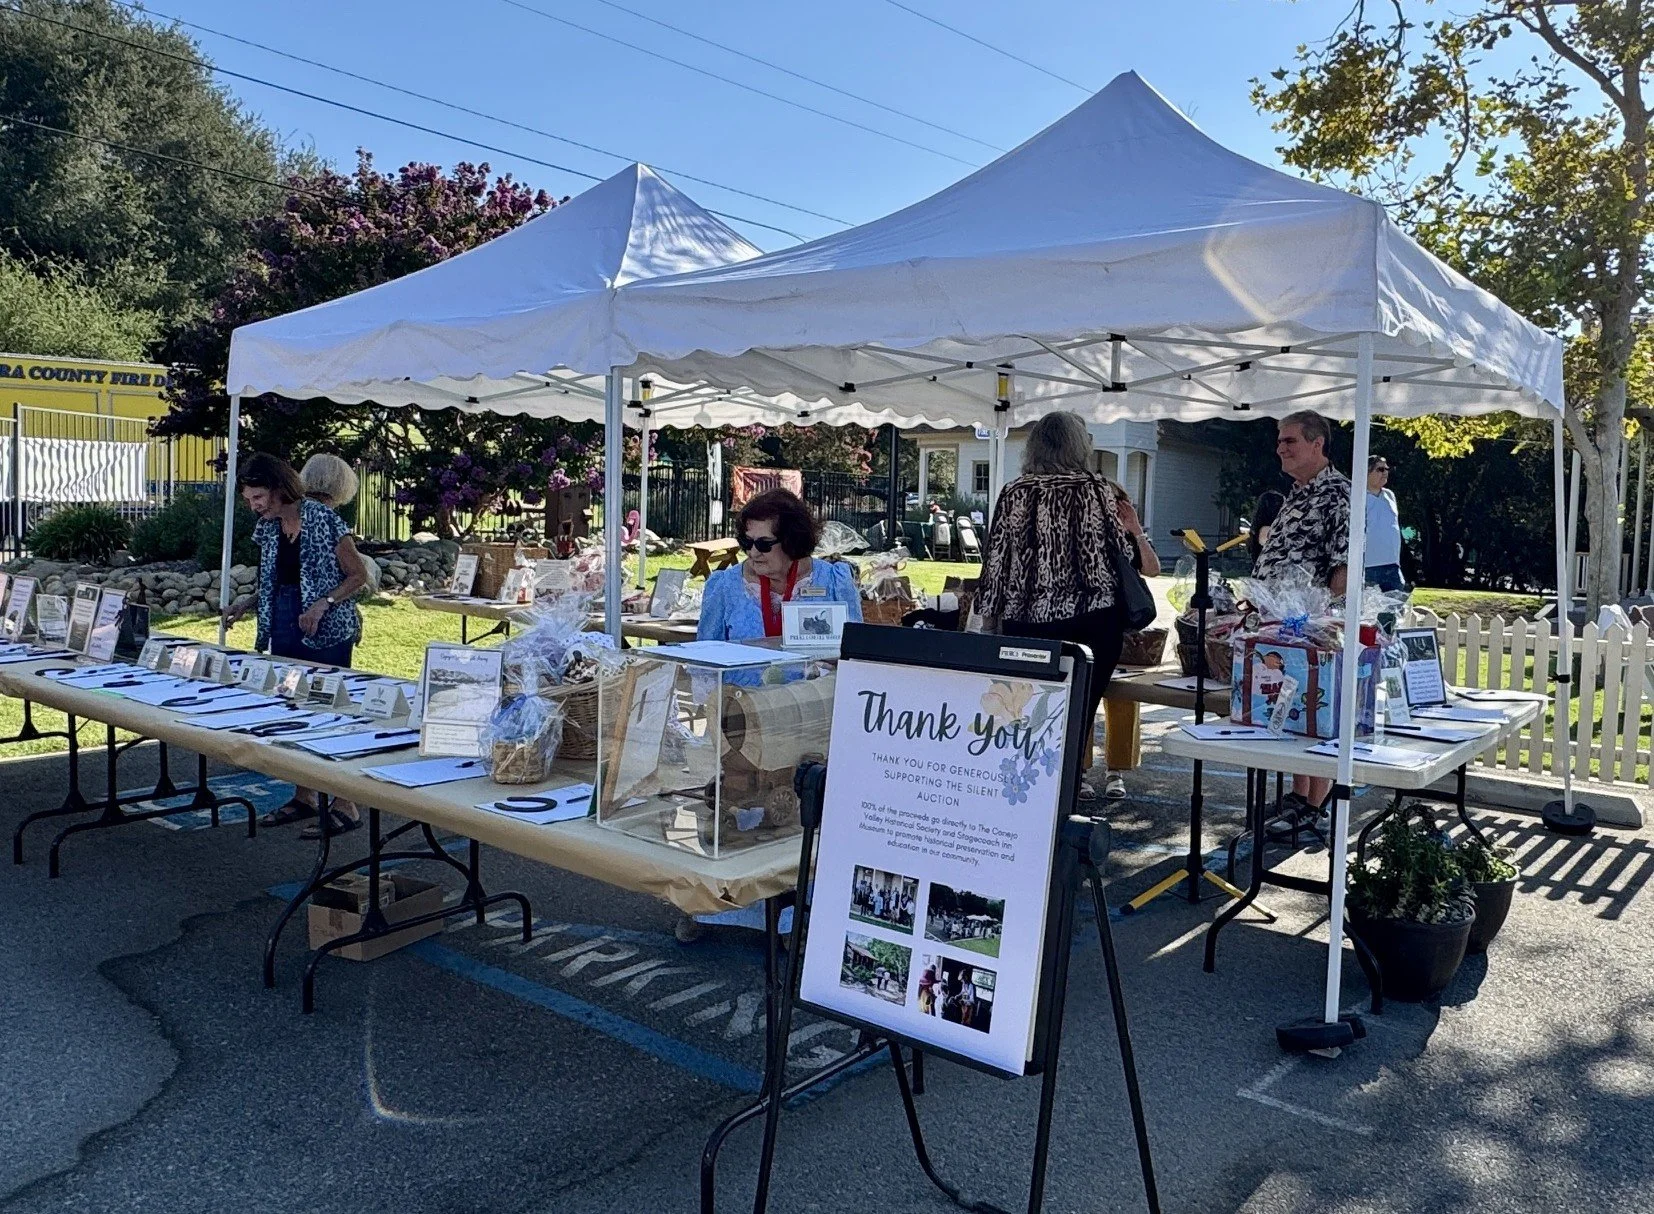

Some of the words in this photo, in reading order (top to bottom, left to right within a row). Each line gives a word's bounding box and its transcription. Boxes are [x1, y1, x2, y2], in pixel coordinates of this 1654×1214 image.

[28, 365, 108, 384] COUNTY
[109, 371, 151, 387] FIRE
[857, 690, 961, 742] Thank
[967, 712, 1038, 760] you
[872, 752, 900, 765] THANK
[903, 757, 924, 769] YOU
[926, 761, 946, 772] FOR
[884, 769, 942, 788] SUPPORTING
[946, 780, 963, 792] THE
[966, 784, 999, 798] SILENT
[916, 791, 960, 807] AUCTION
[861, 800, 877, 812] 100%
[878, 804, 885, 813] of
[887, 806, 897, 815] the
[899, 810, 929, 822] proceeds
[931, 816, 940, 825] go
[942, 817, 967, 831] directly
[969, 823, 976, 831] to
[978, 823, 990, 834] The
[992, 827, 1018, 841] Conejo
[864, 811, 883, 825] Valley
[884, 816, 915, 830] Historical
[916, 822, 940, 836] Society
[942, 829, 956, 838] and
[957, 831, 1000, 847] Stagecoach
[859, 821, 886, 834] Museum
[887, 828, 894, 836] to
[895, 830, 923, 843] promote
[924, 836, 955, 849] historical
[956, 843, 999, 859] preservation
[1001, 852, 1015, 862] and
[887, 839, 920, 852] education
[929, 849, 941, 857] our
[942, 851, 980, 867] community.
